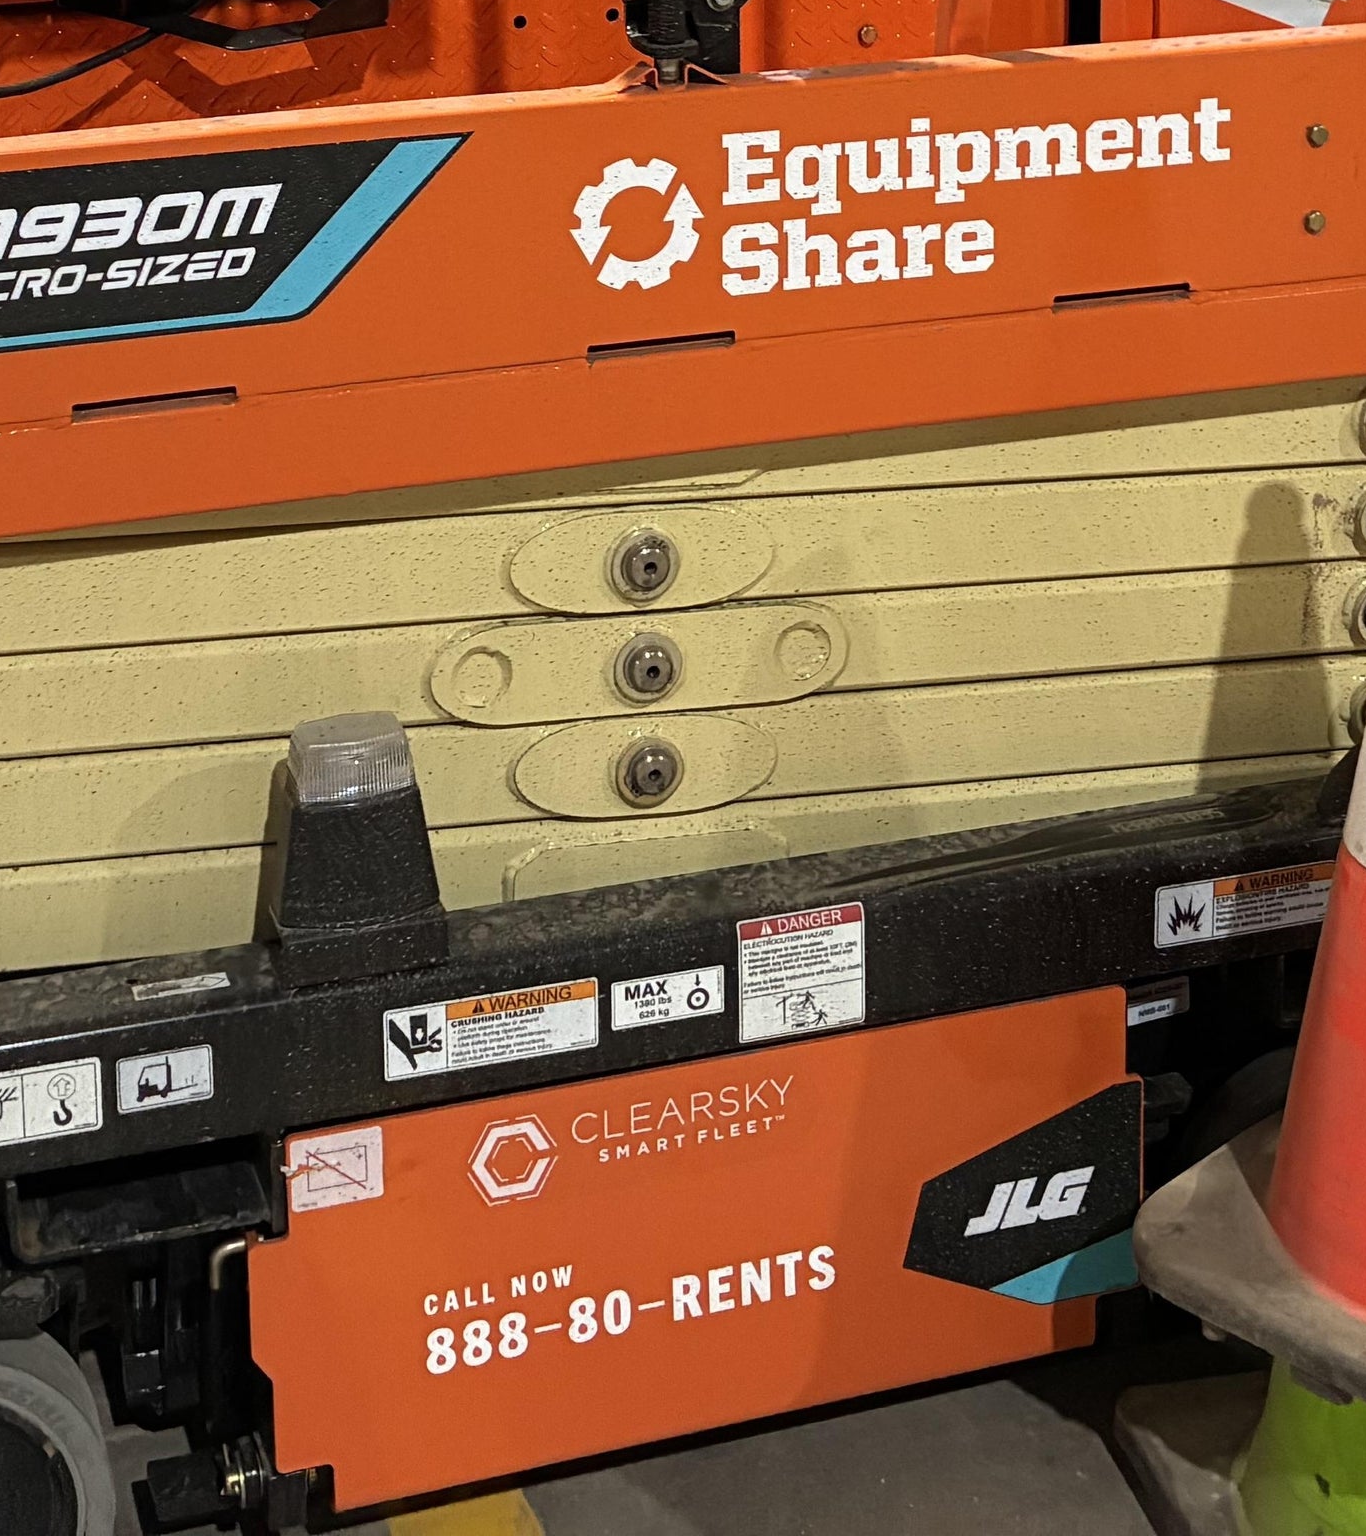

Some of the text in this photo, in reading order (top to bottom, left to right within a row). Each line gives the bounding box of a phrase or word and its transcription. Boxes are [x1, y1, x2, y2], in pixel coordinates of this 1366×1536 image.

[721, 97, 1231, 216] Equipment
[721, 218, 995, 297] Share
[1250, 868, 1313, 889] WARNING
[777, 909, 842, 932] DANGER
[805, 929, 833, 939] HAZARD
[490, 985, 572, 1011] WARNING
[625, 980, 668, 1001] MAX
[658, 996, 672, 1004] lbs
[451, 1006, 545, 1028] CRUSHING HAZARD
[658, 1008, 670, 1016] kg
[571, 1075, 794, 1144] CLEARSKY
[599, 1134, 685, 1162] SMART
[963, 1166, 1095, 1237] JLG
[424, 1264, 573, 1316] CALL NOW
[426, 1245, 835, 1375] 888-80-RENTS
